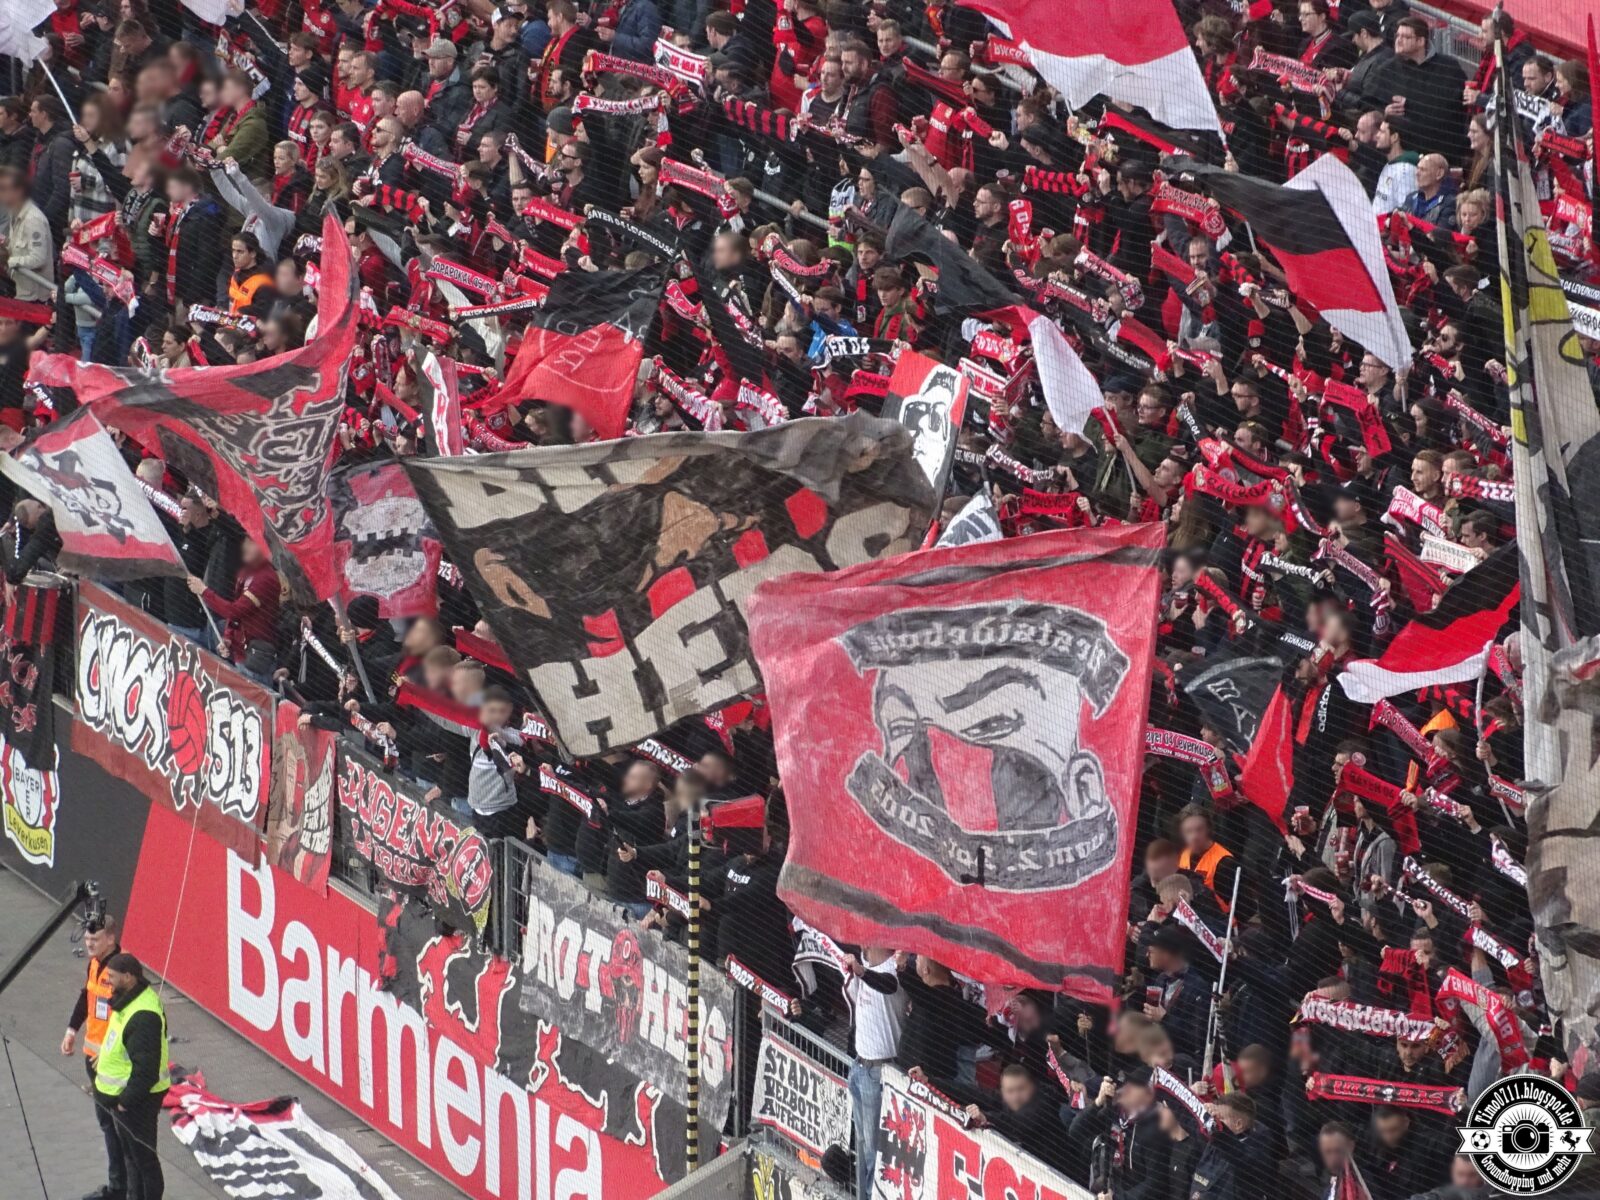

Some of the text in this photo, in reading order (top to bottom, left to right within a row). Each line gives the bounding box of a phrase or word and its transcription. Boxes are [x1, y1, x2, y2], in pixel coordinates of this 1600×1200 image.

[849, 336, 871, 355] 04
[8, 808, 49, 852] Leverkusen
[227, 847, 602, 1200] Barmenia
[639, 956, 730, 1090] HES
[763, 1043, 823, 1104] STADT
